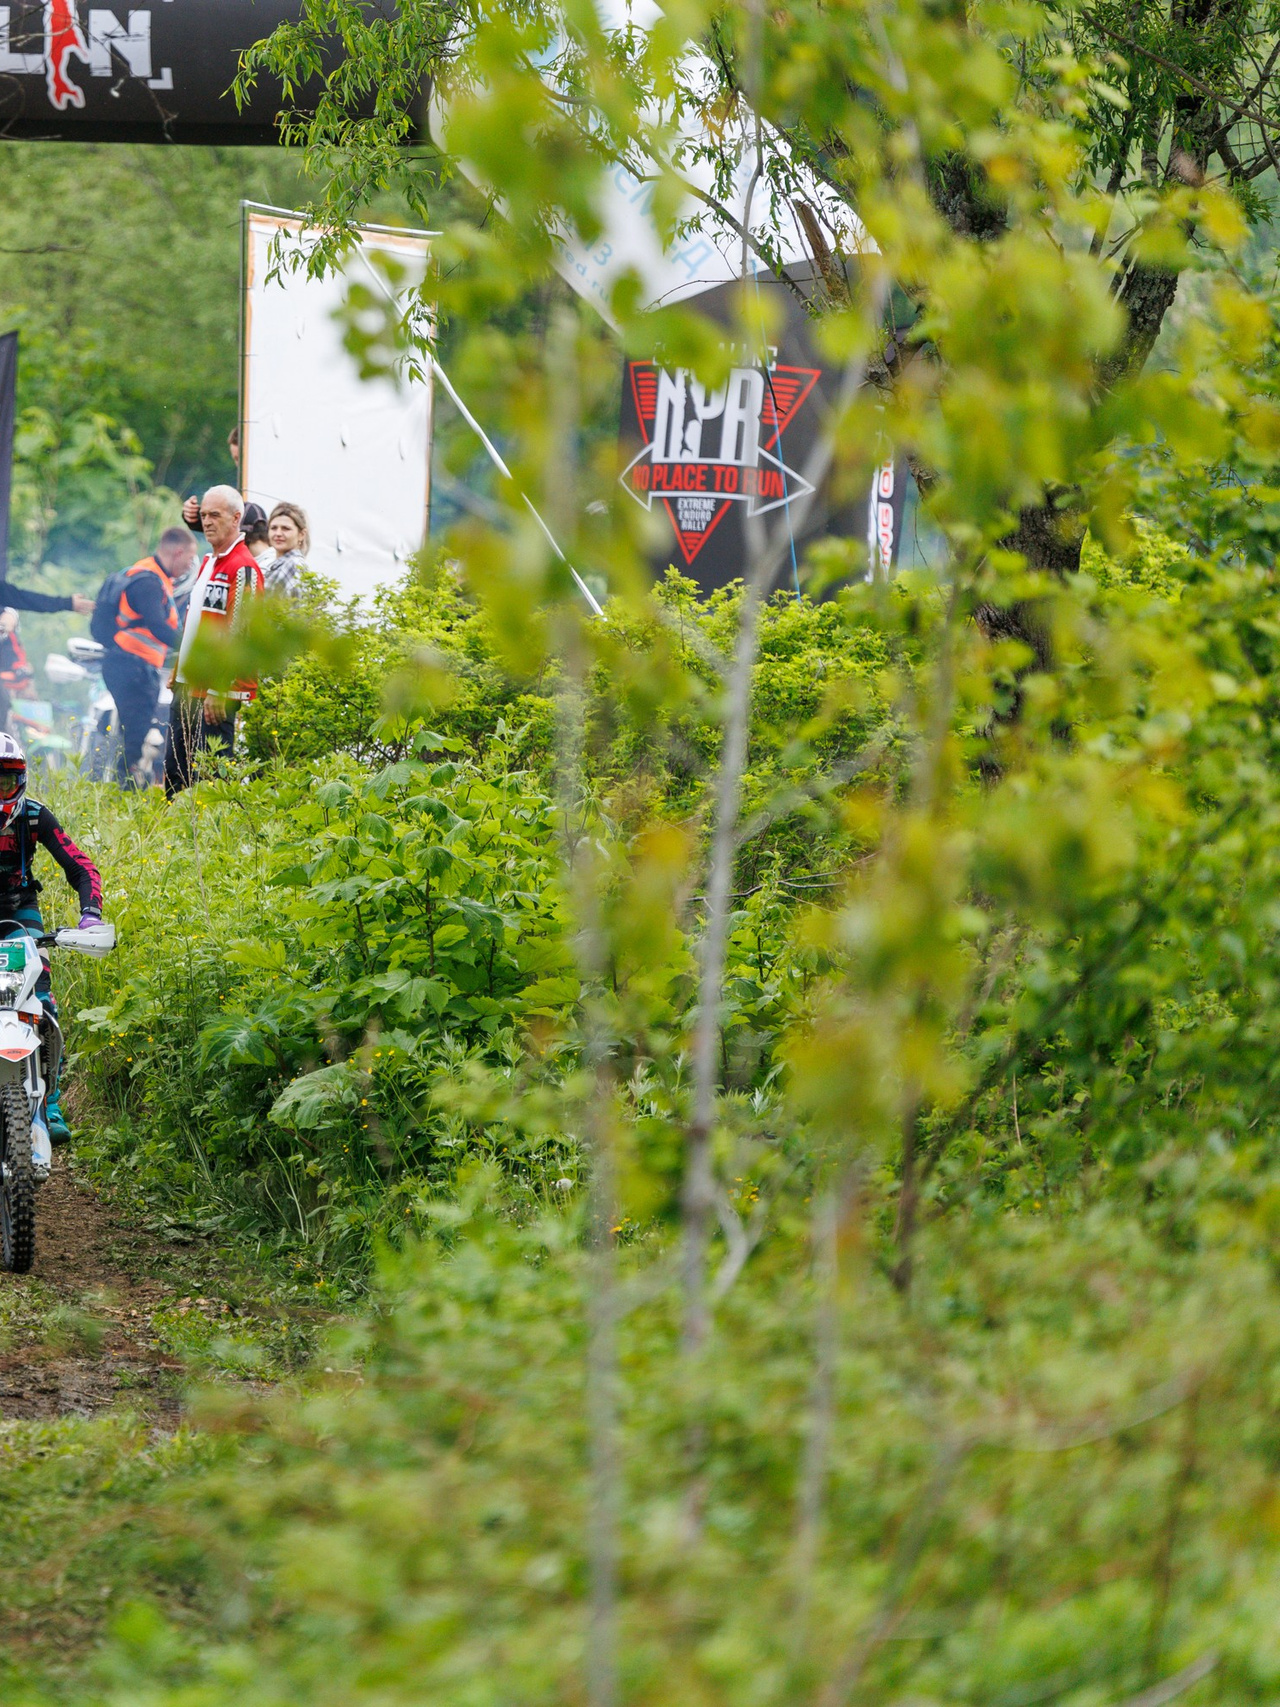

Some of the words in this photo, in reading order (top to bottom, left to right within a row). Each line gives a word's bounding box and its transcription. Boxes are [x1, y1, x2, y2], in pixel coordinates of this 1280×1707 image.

[631, 464, 651, 491] NO
[652, 464, 708, 492] PLACE
[713, 465, 739, 493] TO
[742, 466, 785, 499] RUN
[677, 497, 716, 512] EXTREME
[678, 510, 712, 522] ENDURO
[681, 521, 707, 532] RALLY
